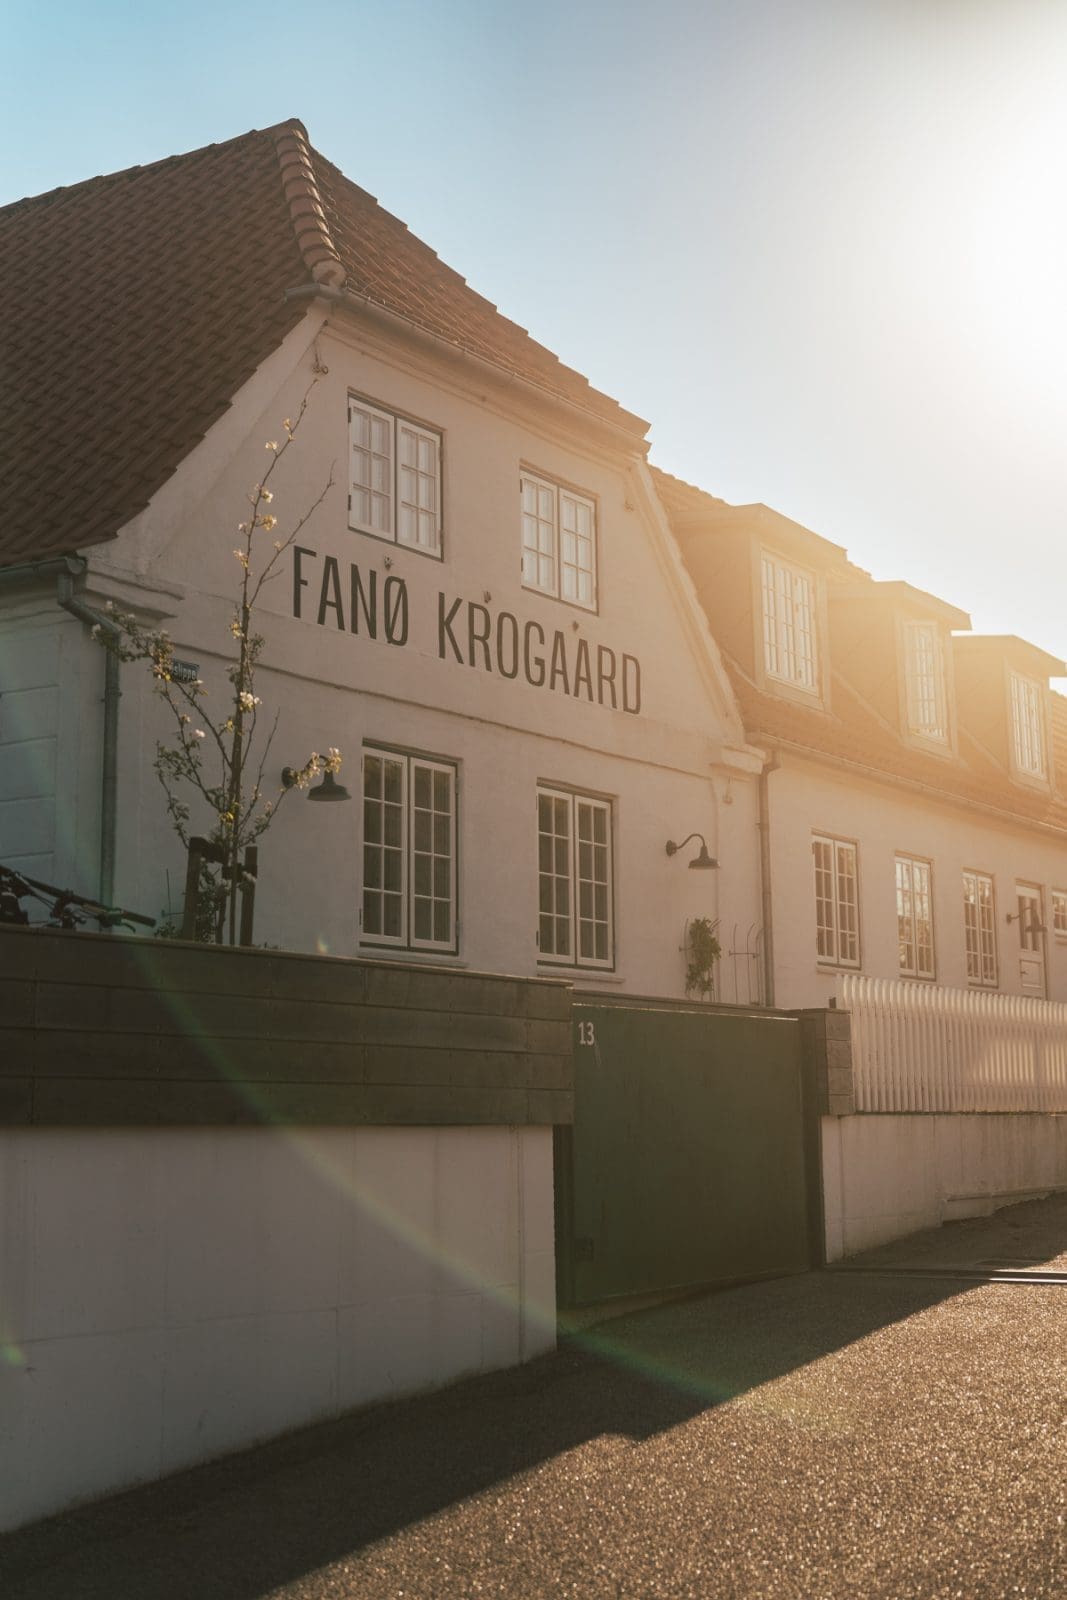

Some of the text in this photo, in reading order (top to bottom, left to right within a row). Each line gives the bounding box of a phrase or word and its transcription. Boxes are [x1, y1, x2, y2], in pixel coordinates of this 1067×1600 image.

[293, 545, 641, 715] FANØ KROGAARD
[578, 1021, 595, 1046] 13
